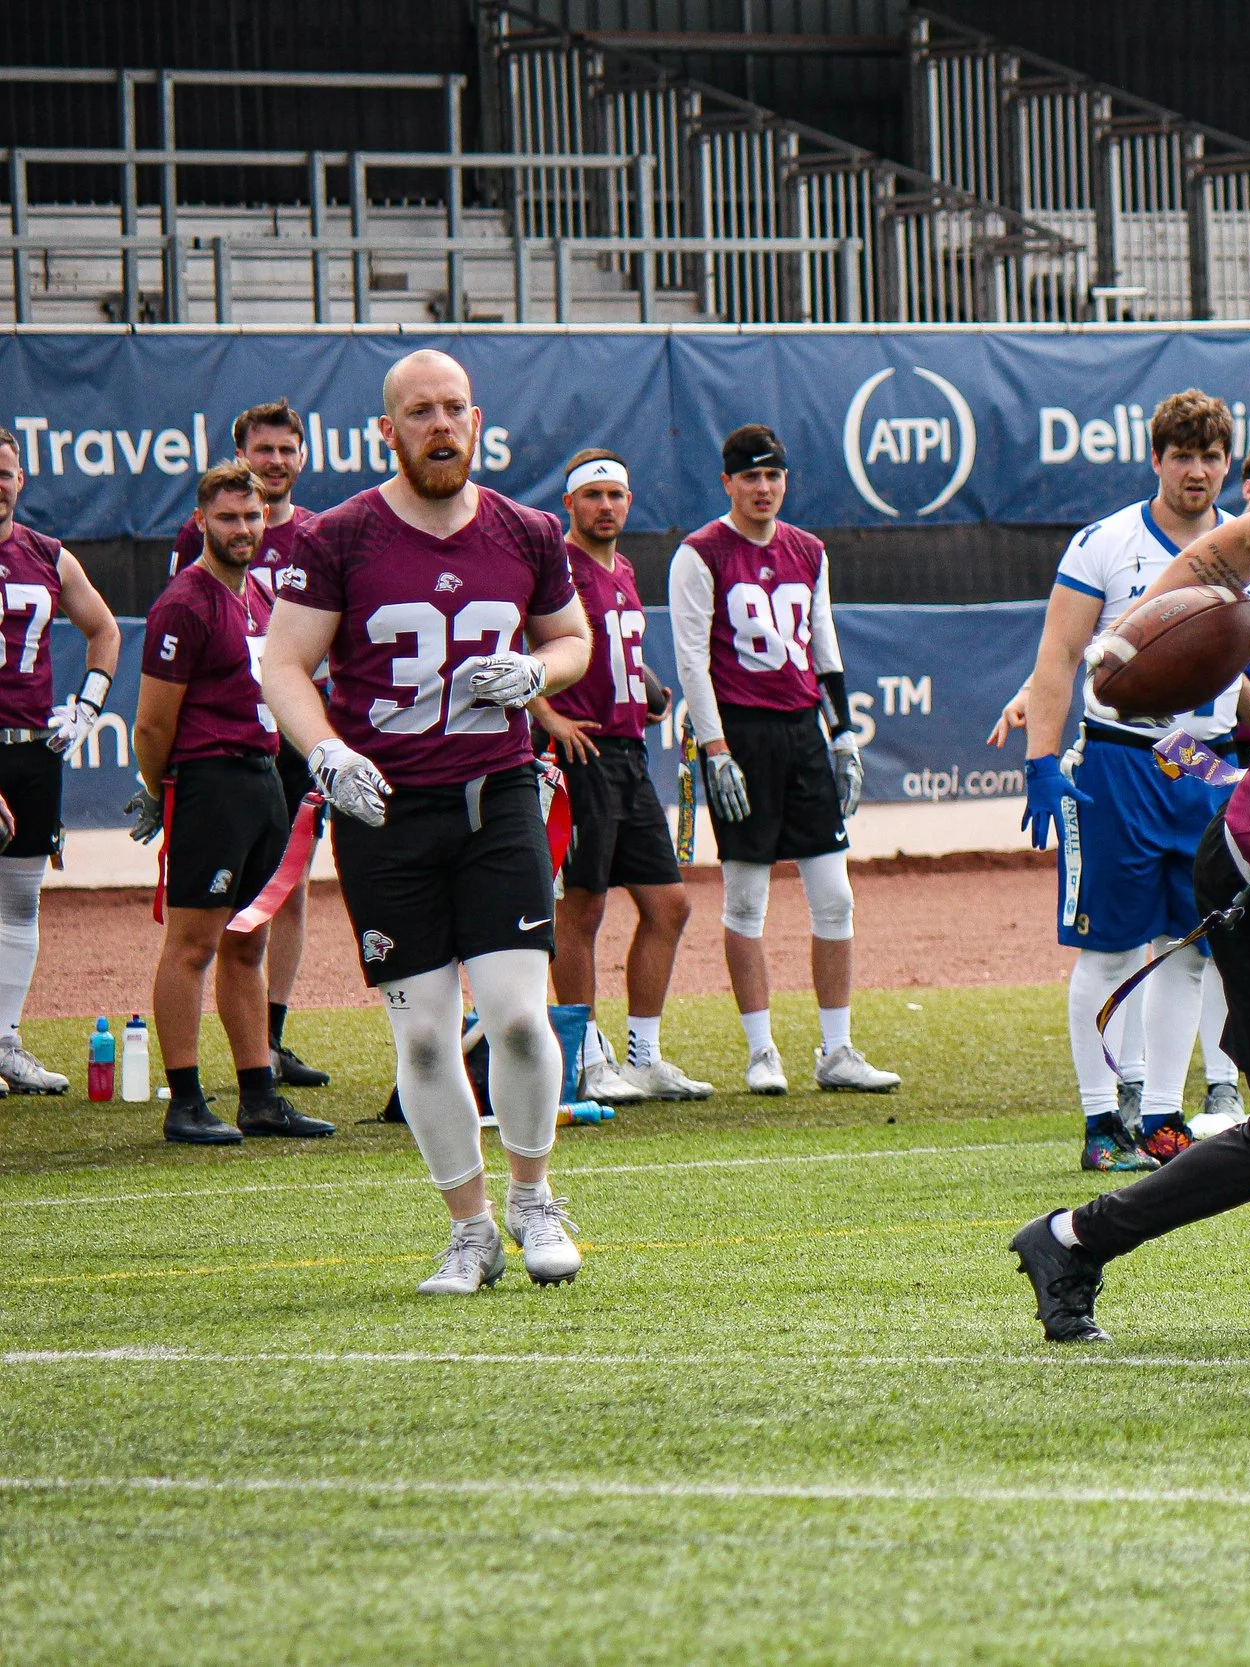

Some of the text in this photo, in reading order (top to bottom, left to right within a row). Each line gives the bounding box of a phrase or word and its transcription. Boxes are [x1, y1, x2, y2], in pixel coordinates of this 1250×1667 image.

[14, 412, 208, 476] Travel
[0, 582, 52, 674] 7
[160, 633, 178, 662] 5
[366, 600, 521, 735] 32
[604, 609, 648, 705] 13
[727, 582, 813, 672] 80
[902, 764, 1025, 802] atpi.com
